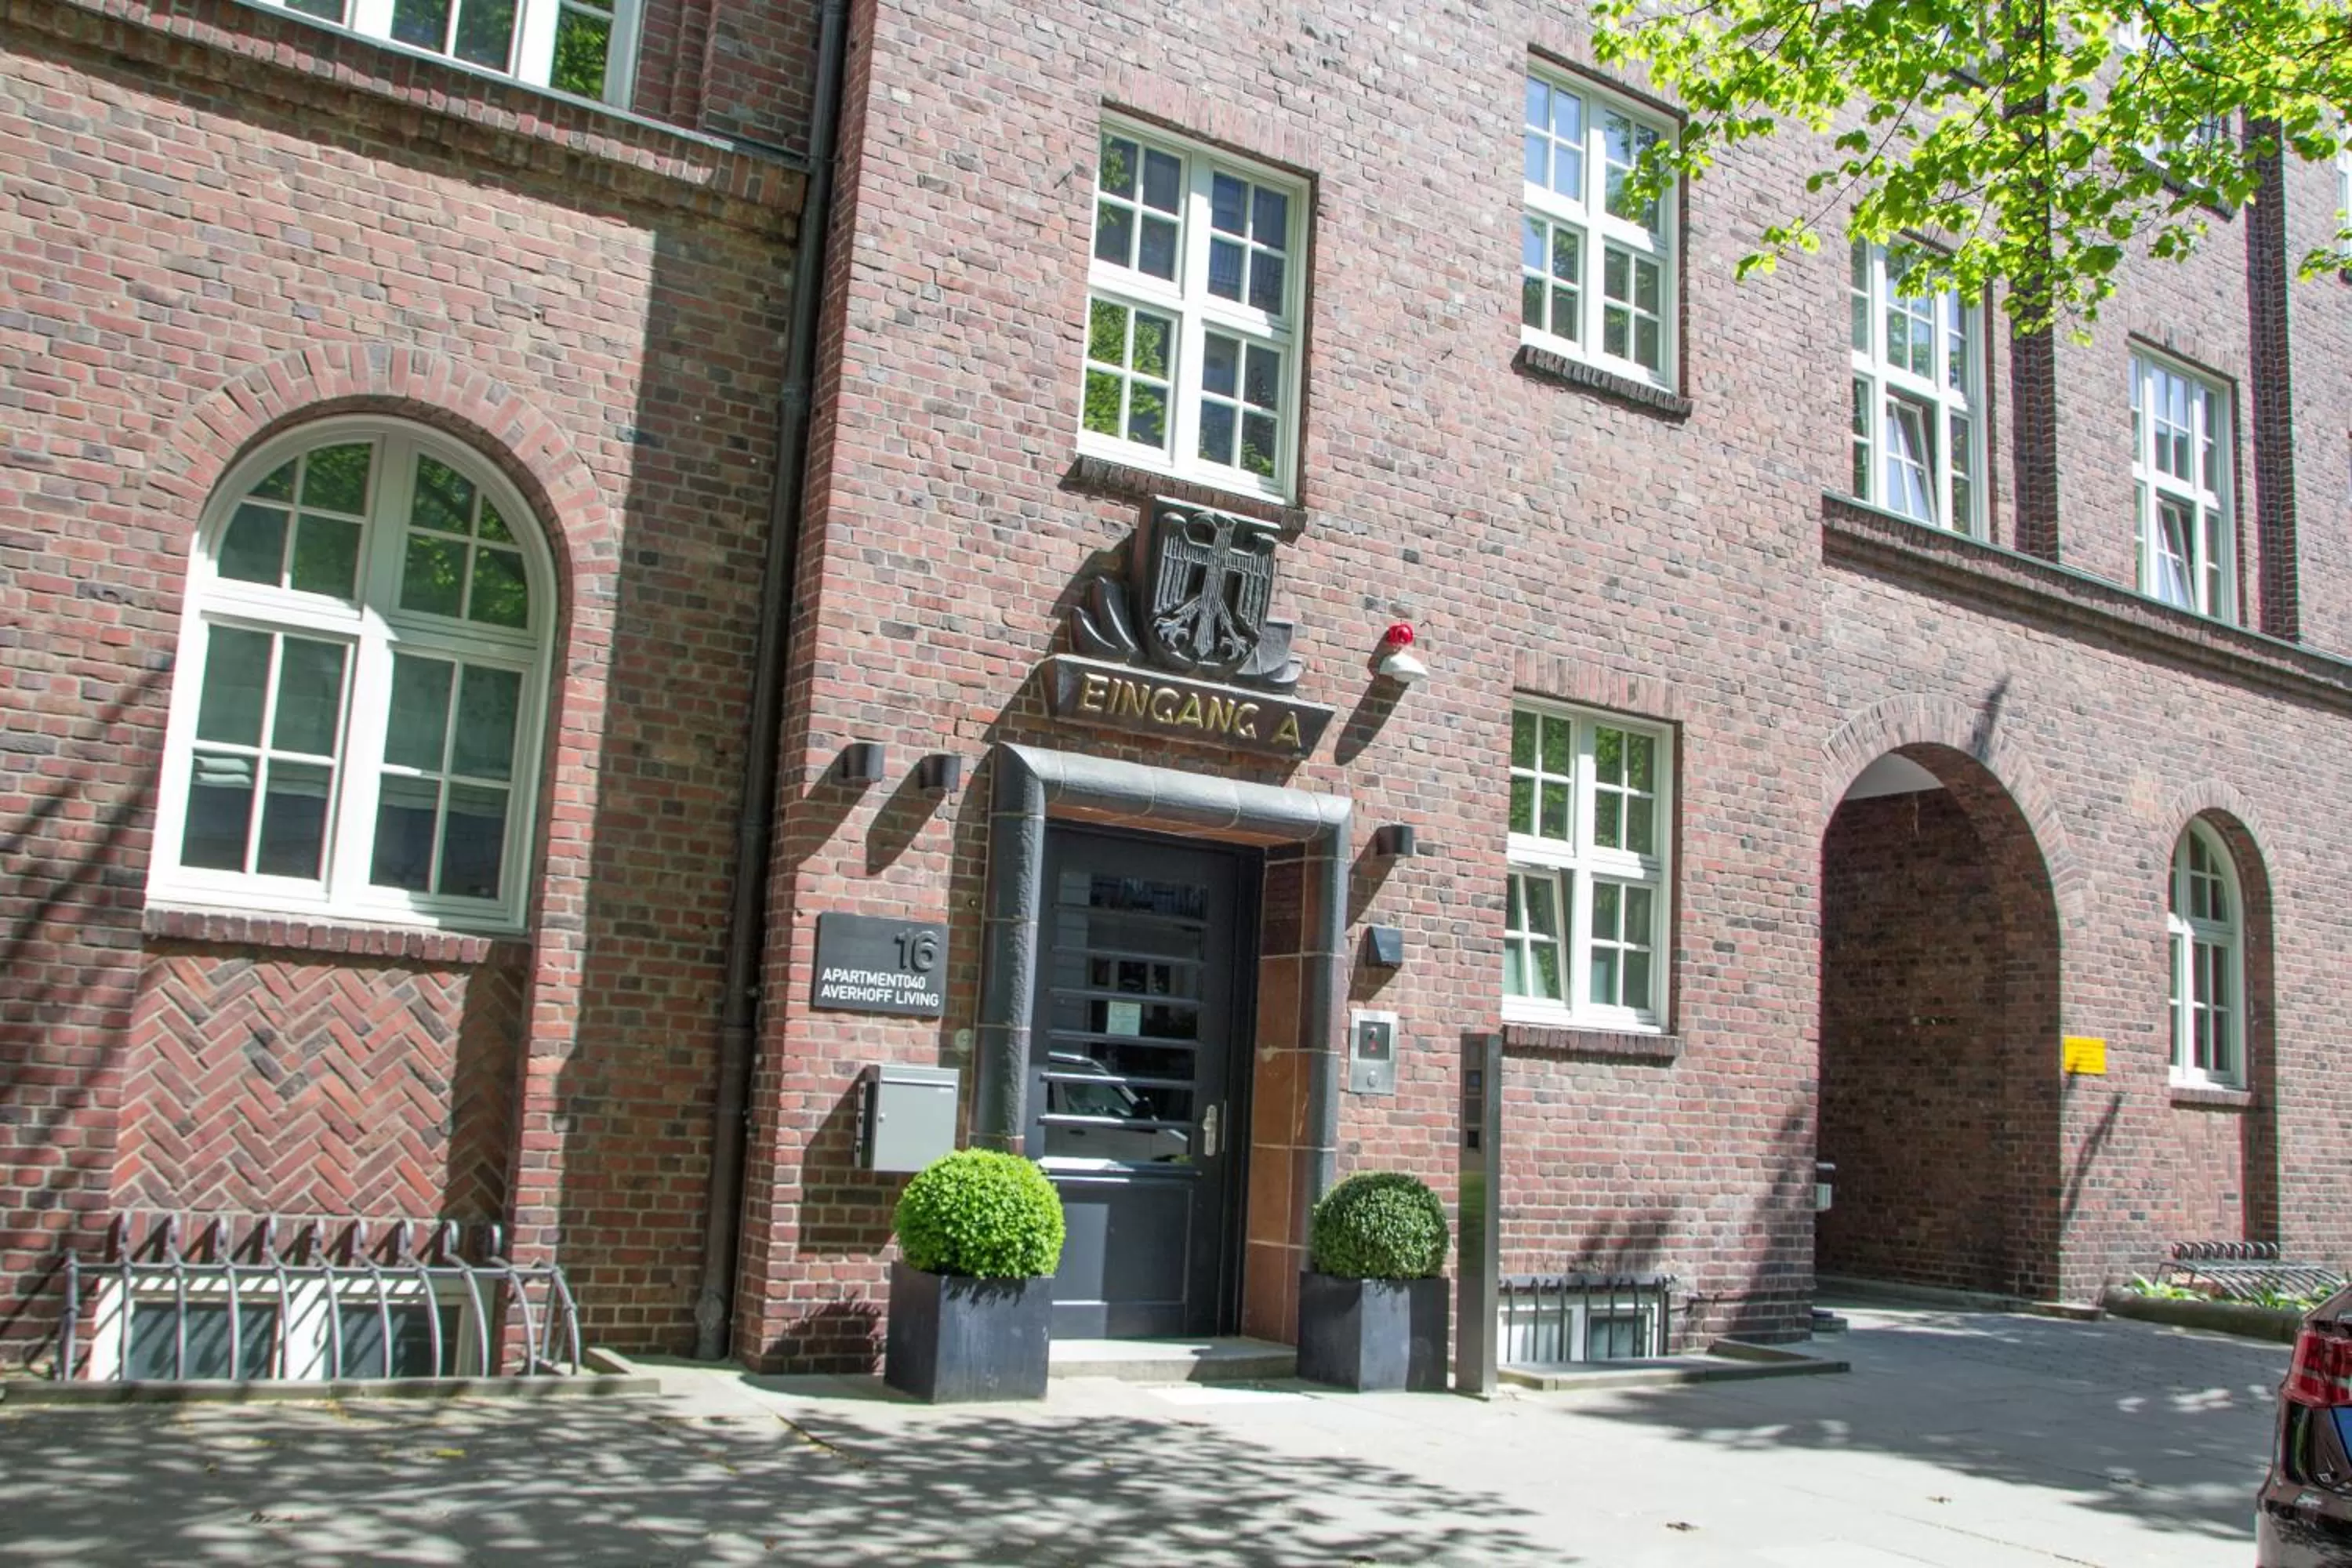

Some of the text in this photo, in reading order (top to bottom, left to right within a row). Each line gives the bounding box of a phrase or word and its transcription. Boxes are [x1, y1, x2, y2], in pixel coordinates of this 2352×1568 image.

[1079, 673, 1302, 749] EINGANG A
[894, 929, 940, 973] 16
[821, 985, 939, 1007] AVERHOFF LIVING
